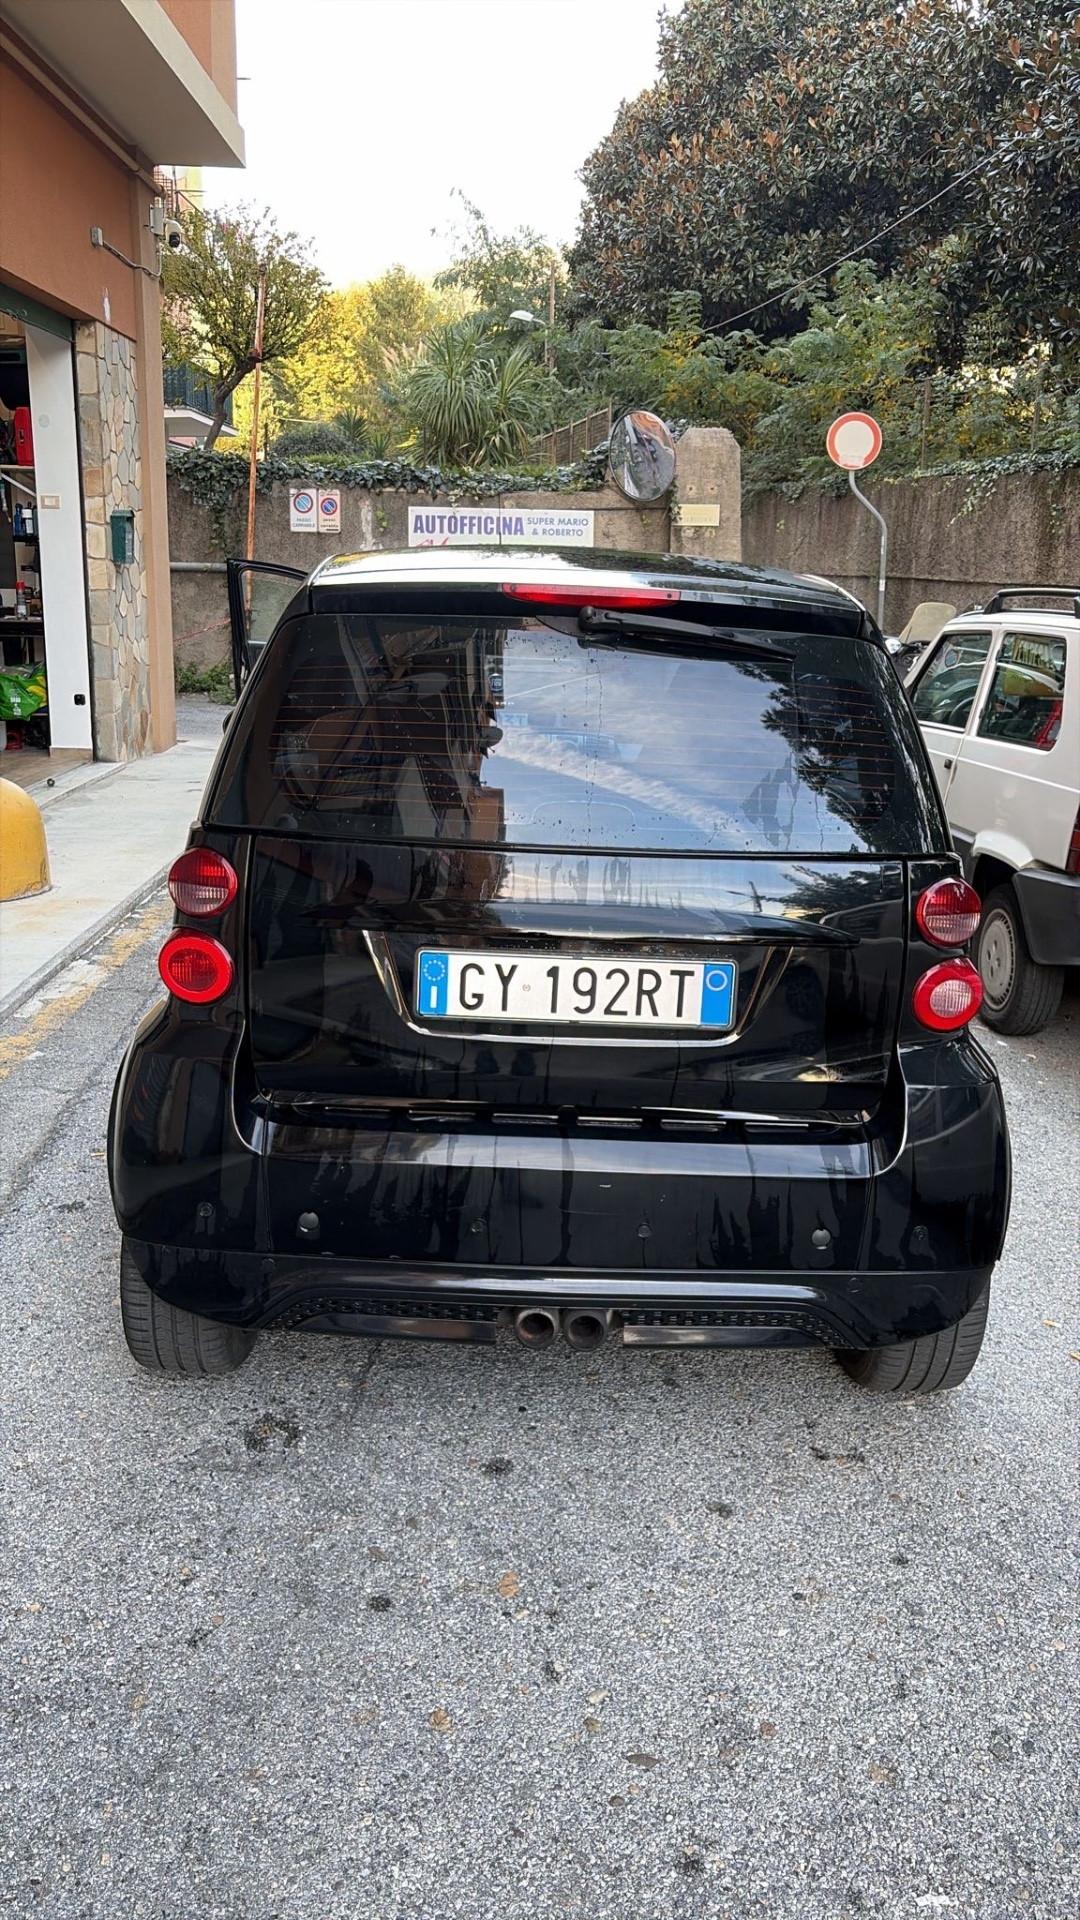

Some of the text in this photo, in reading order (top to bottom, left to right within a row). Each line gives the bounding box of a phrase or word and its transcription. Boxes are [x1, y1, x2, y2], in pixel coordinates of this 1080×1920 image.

[413, 514, 525, 536] AUTOFFICINA
[527, 517, 589, 527] SUPER MARIO
[542, 528, 584, 537] ROBERTO
